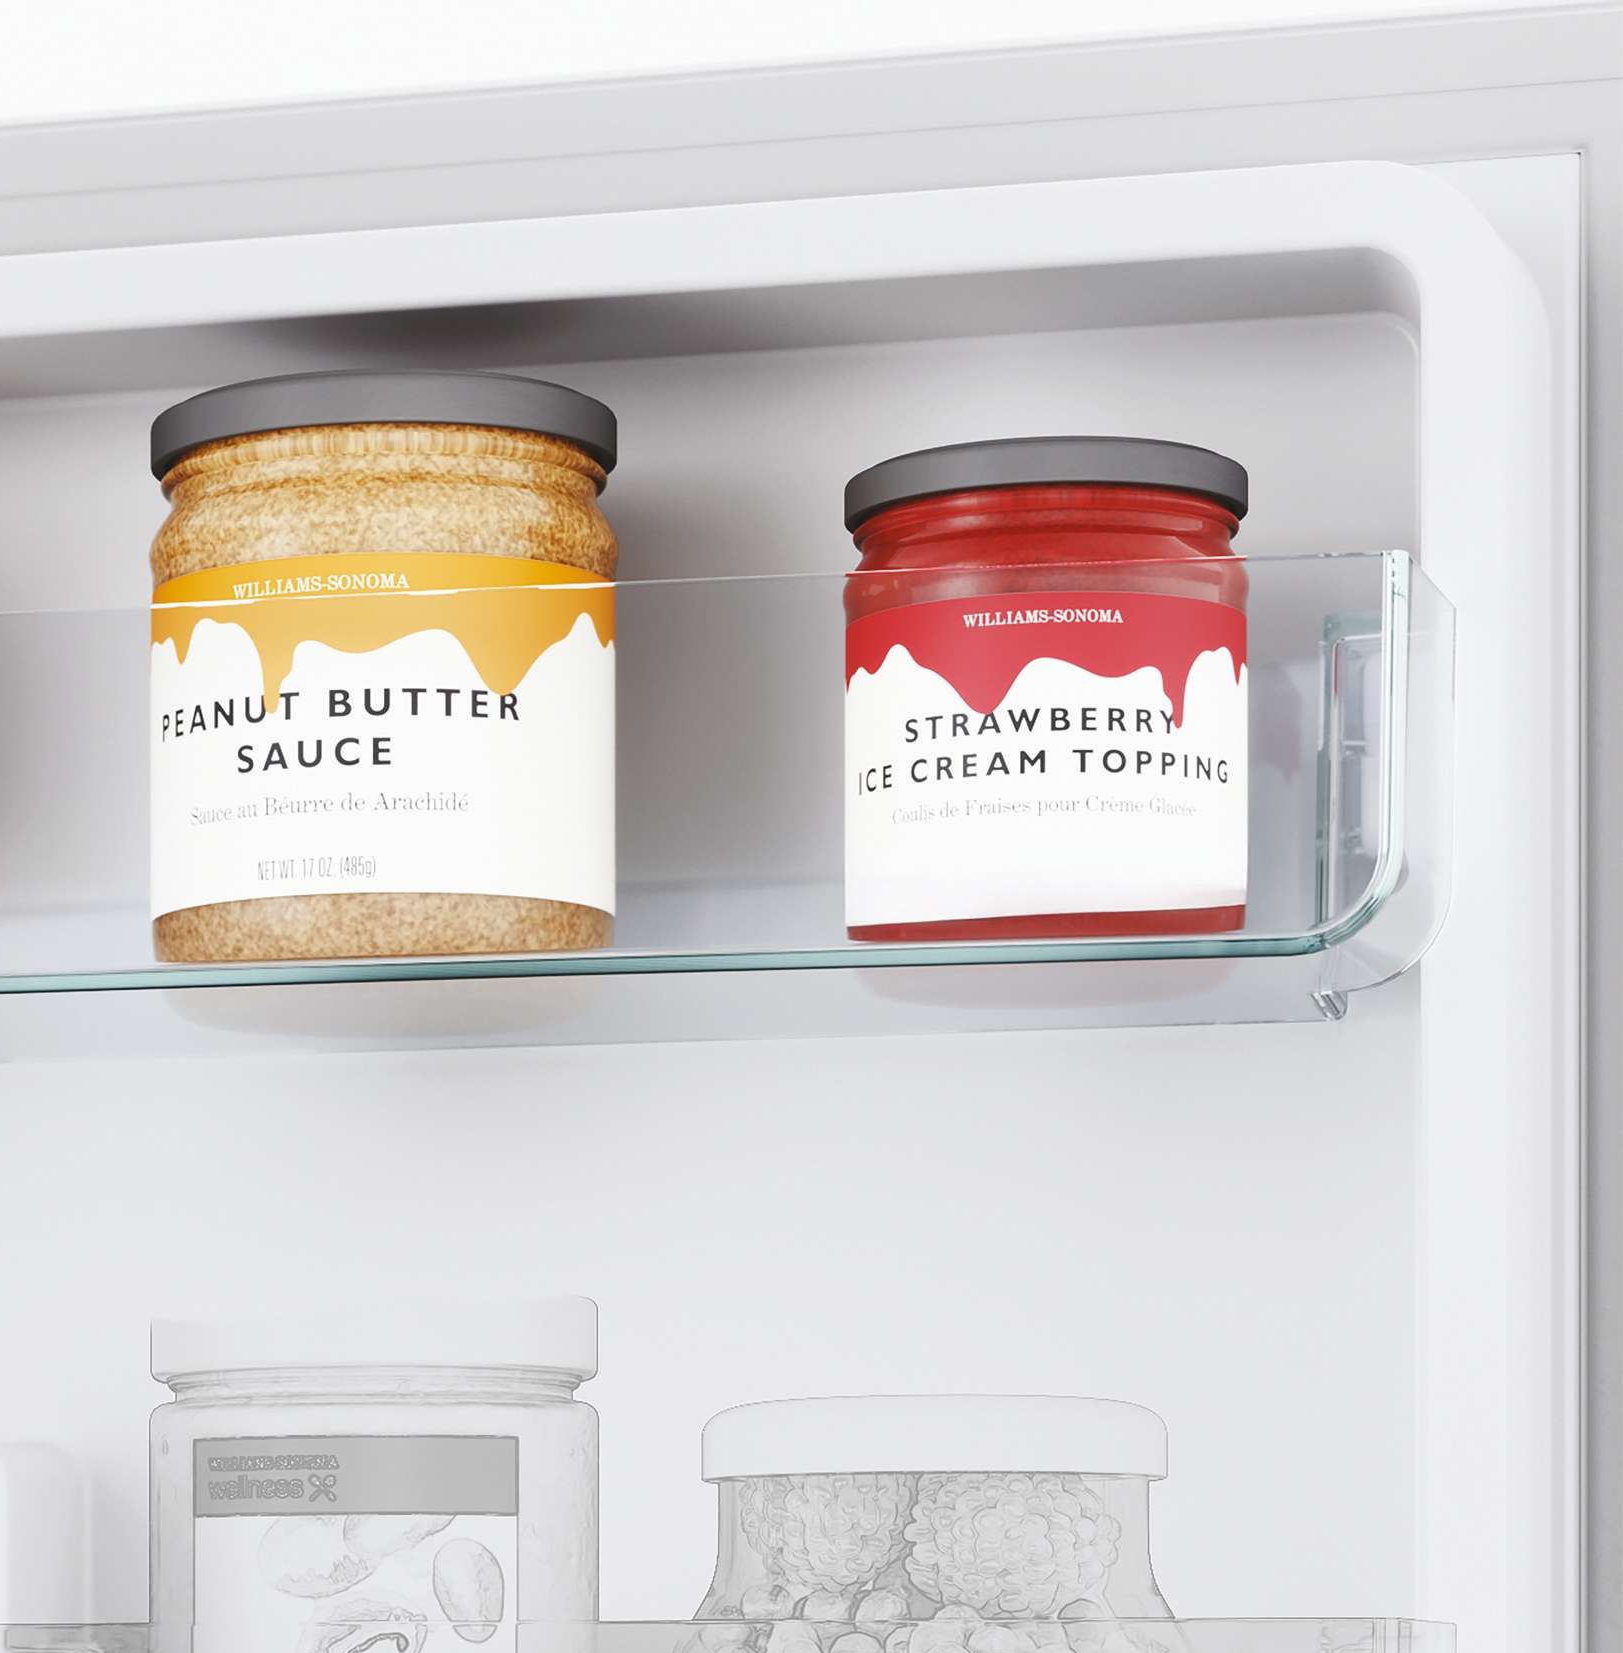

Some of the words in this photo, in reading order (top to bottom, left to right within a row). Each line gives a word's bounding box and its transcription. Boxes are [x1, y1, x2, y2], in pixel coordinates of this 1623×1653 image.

[232, 573, 410, 600] WILLIAMS-SONOMA
[963, 608, 1124, 628] WILLIAMS-SONOMA
[161, 691, 300, 743] PEANUT
[328, 687, 520, 721] BUTTER
[904, 706, 1175, 743] STRAWBERRY
[236, 736, 392, 774] SAUCE
[857, 763, 893, 797] ICE
[910, 749, 1047, 784] CREAM
[1072, 748, 1229, 784] TOPPING
[190, 806, 233, 827] Sauce
[237, 803, 258, 820] au
[340, 792, 366, 812] de
[373, 791, 470, 813] Arachidé
[892, 804, 936, 825] Coulis
[939, 801, 959, 819] de
[965, 798, 1032, 816] Fraises
[1037, 799, 1080, 817] pour
[1085, 795, 1144, 814] Crème
[1149, 797, 1197, 817] Glacée
[257, 860, 276, 881] NET
[302, 857, 315, 879] 17
[339, 855, 377, 879] (485g)
